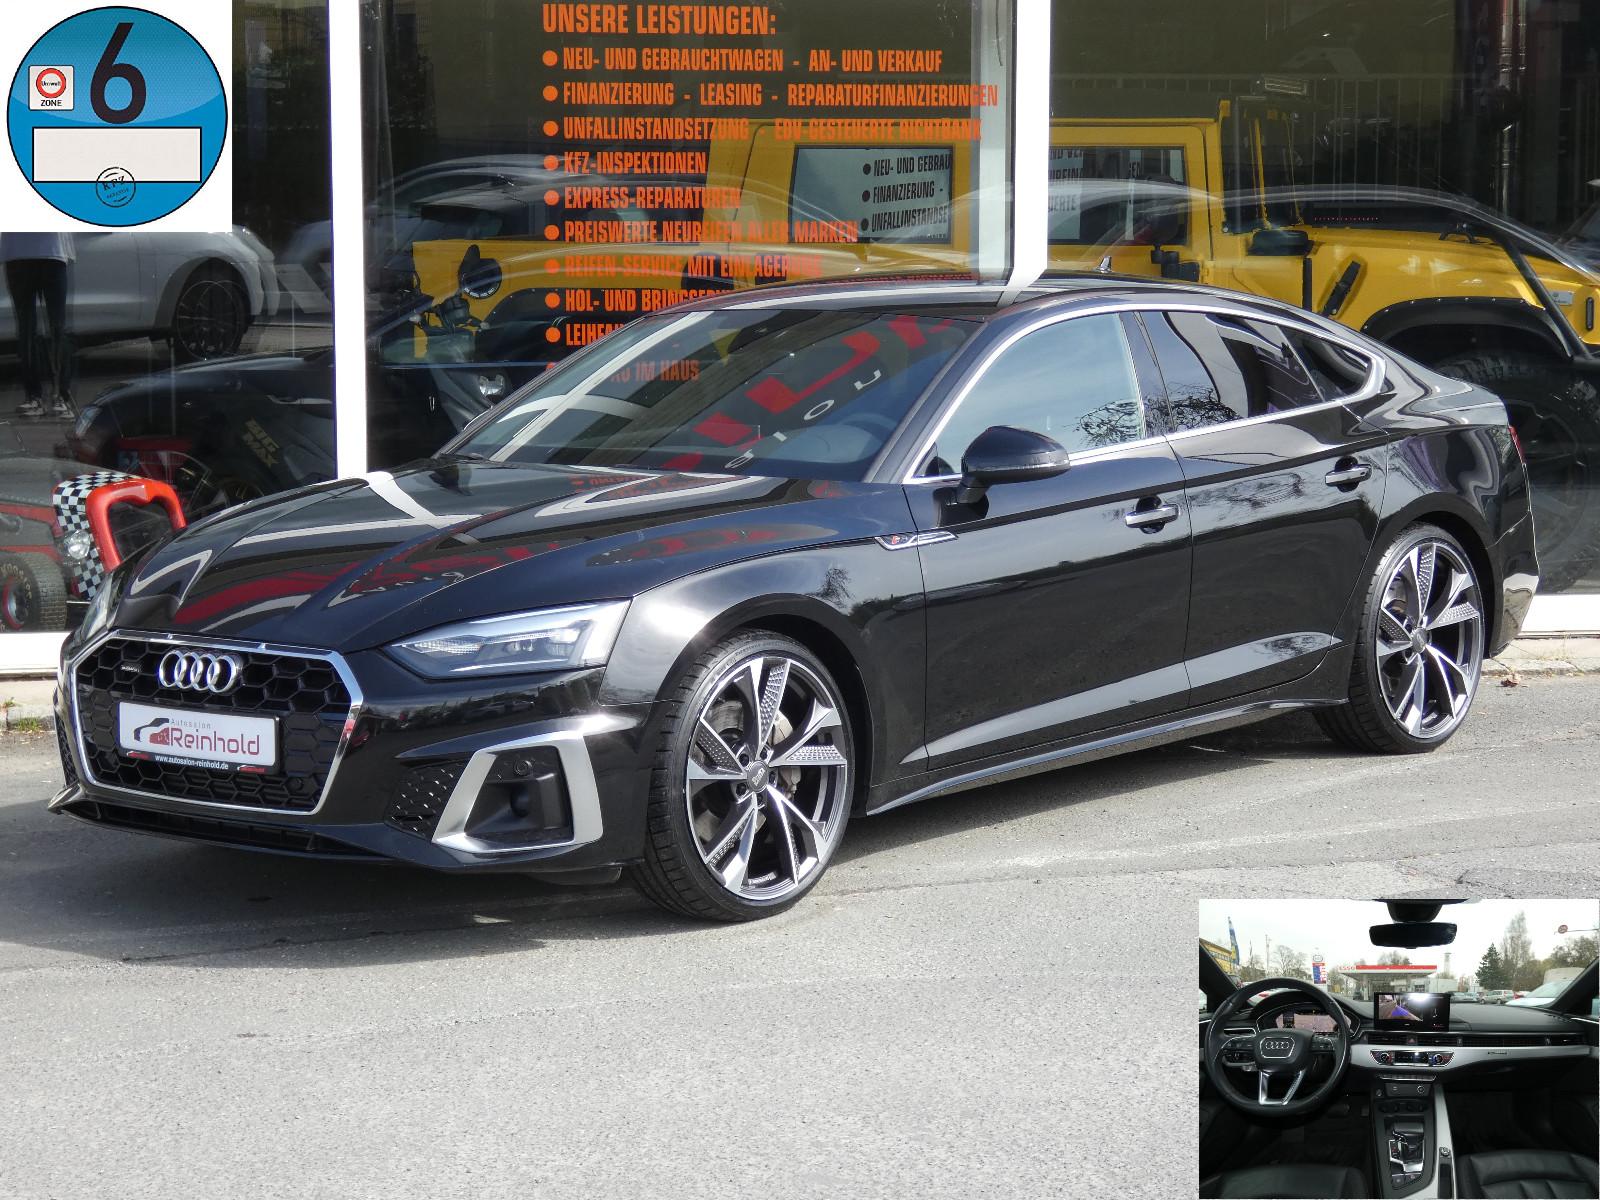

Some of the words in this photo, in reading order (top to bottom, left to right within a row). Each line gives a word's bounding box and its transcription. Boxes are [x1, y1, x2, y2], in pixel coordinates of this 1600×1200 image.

[542, 3, 629, 33] UNSERE
[636, 5, 776, 35] LEISTUNGEN:
[563, 47, 600, 70] NEU-
[604, 47, 637, 70] UND
[642, 48, 784, 71] GEBRAUCHTWAGEN
[808, 49, 837, 72] AN-
[841, 49, 873, 72] UND
[877, 49, 943, 73] VERKAUF
[563, 82, 675, 105] FINANZIERUNG
[700, 83, 762, 106] LEASING
[787, 83, 998, 107] REPARATURFINANZIERUNGEN
[563, 117, 749, 140] UNFALLINSTANDSETZUNG
[774, 118, 895, 141] EDV-GESTEUERTE
[899, 118, 982, 141] RICHTBANK
[564, 151, 706, 174] KFZ-INSPEKTIONEN
[896, 156, 915, 174] UND
[564, 186, 741, 209] EXPRESS-REPARATUREN
[872, 180, 935, 203] FINANZIERUNG
[564, 220, 657, 243] PREISWERTE
[662, 220, 742, 243] NEUREIFEN
[794, 220, 859, 243] MARKEN
[687, 255, 716, 278] MIT
[565, 288, 600, 311] HOL-
[604, 288, 637, 311] UND
[660, 359, 700, 382] HAUS
[170, 718, 211, 730] Autosalon
[170, 727, 260, 756] Reinhold
[155, 754, 229, 770] www.autosalon-reinhold.de
